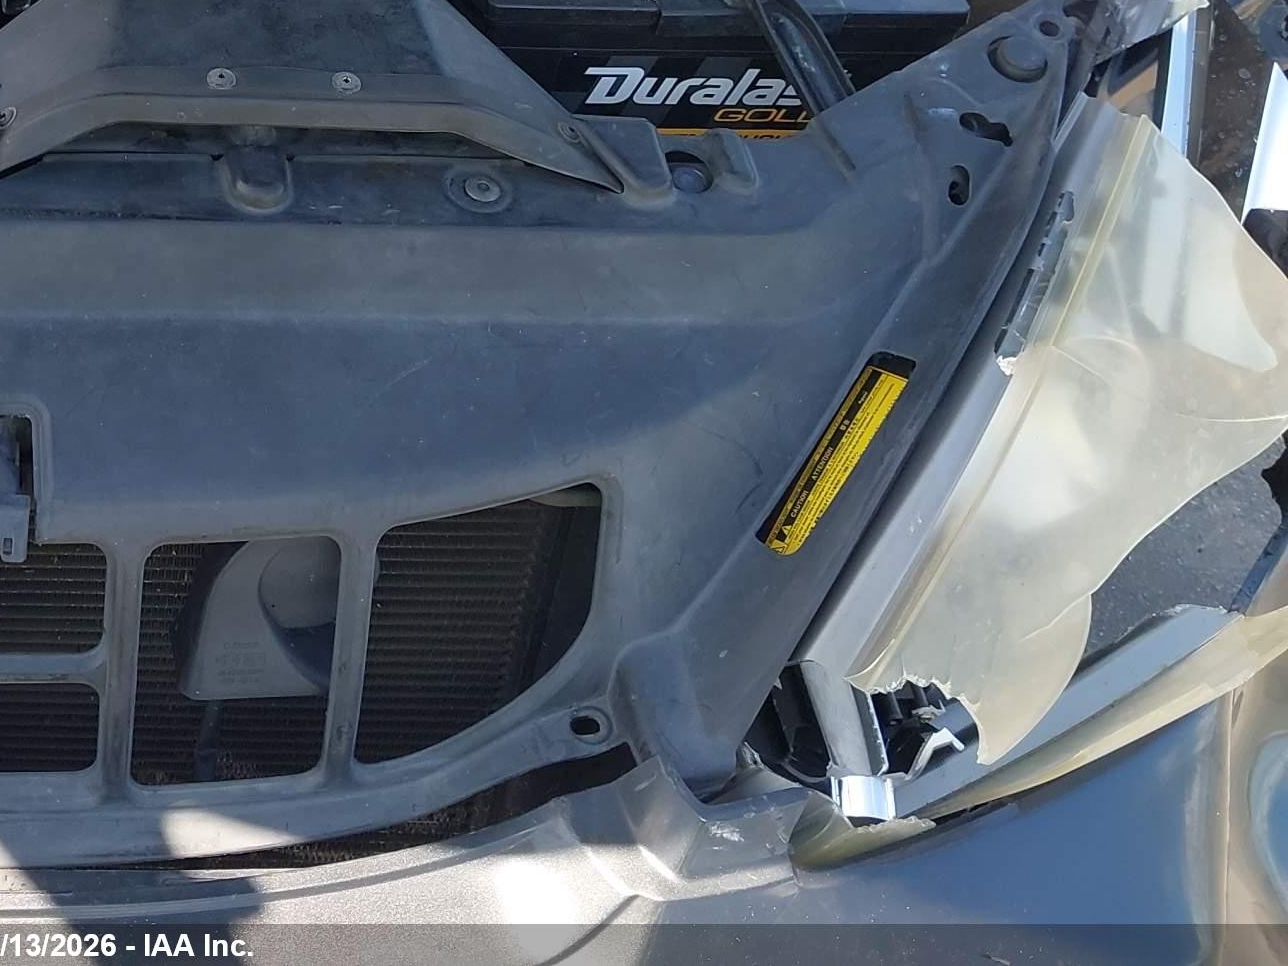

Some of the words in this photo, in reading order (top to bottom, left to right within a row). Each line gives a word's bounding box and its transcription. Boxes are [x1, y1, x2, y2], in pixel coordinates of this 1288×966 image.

[584, 67, 852, 106] Duralas
[790, 490, 809, 518] CAUTION
[811, 446, 834, 481] ATTENTION
